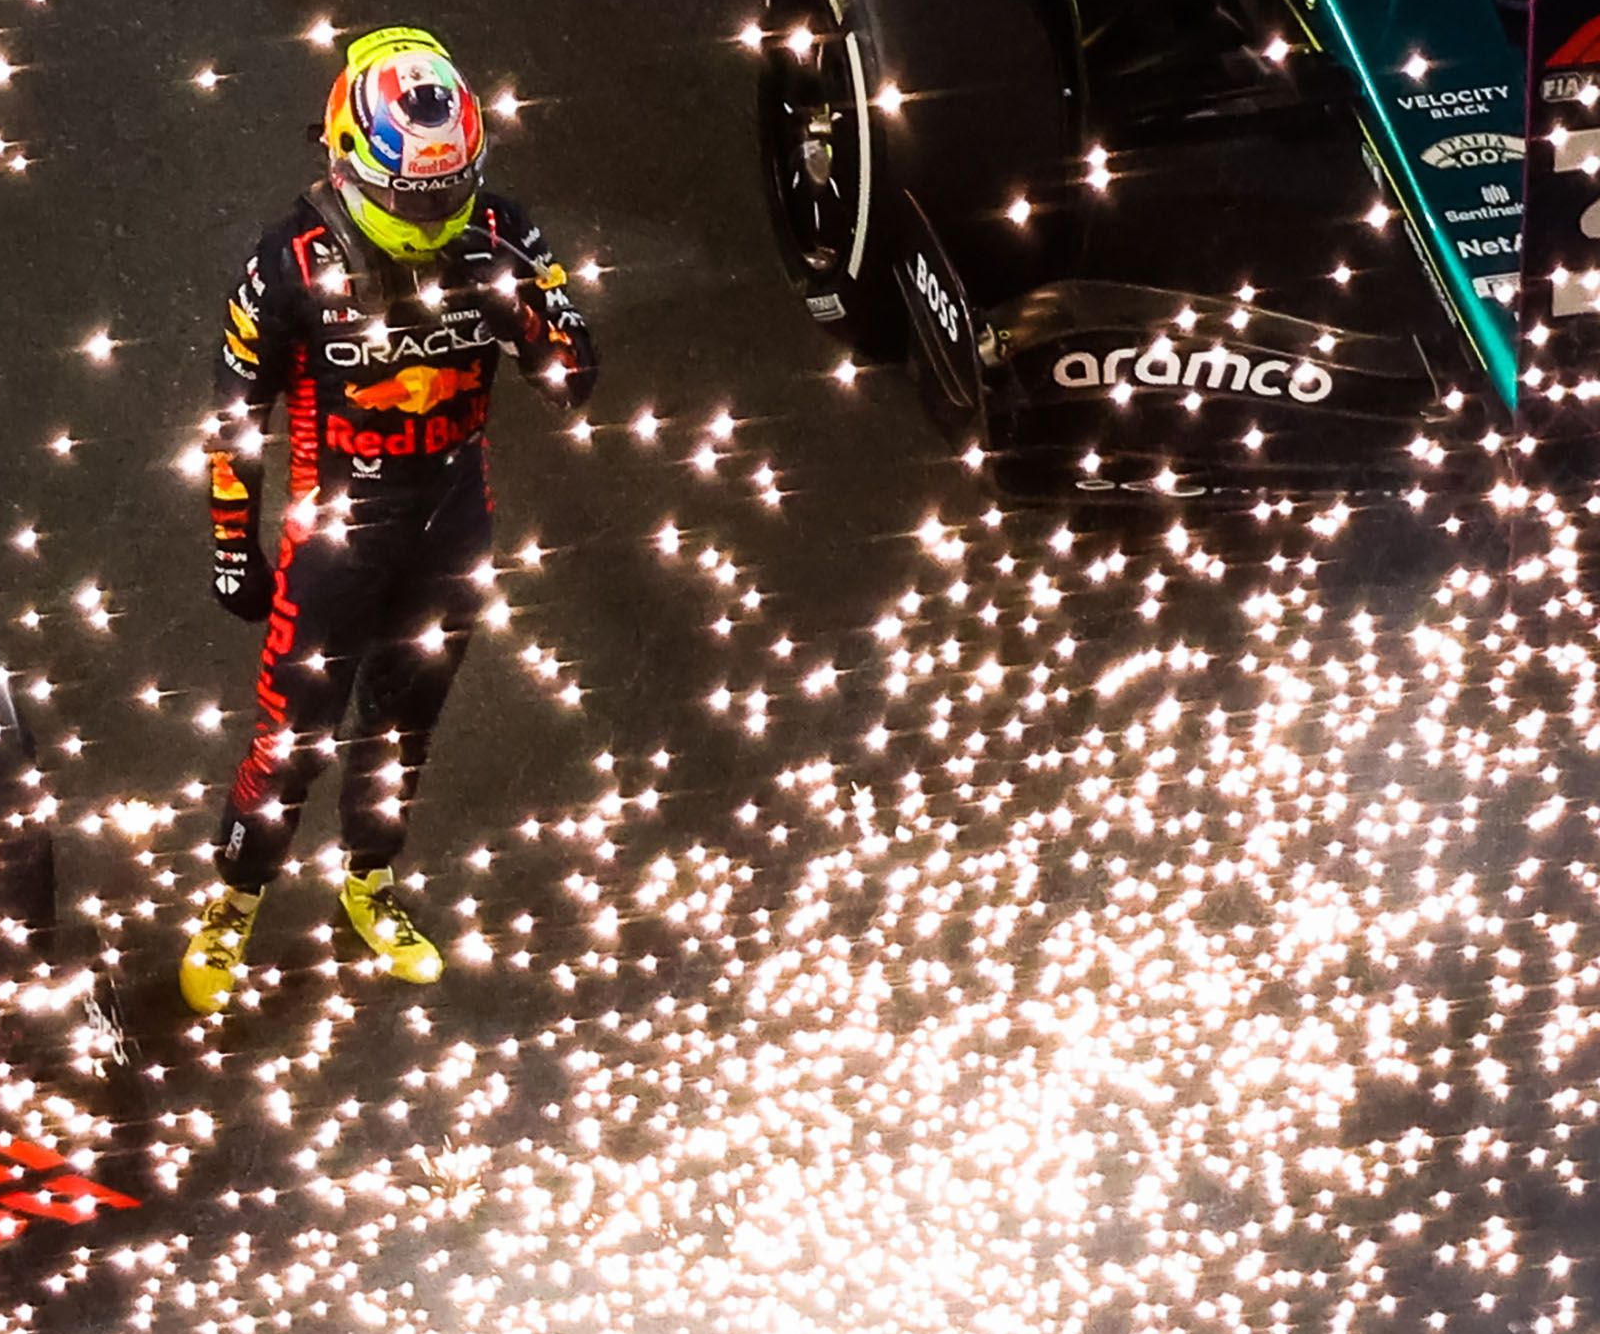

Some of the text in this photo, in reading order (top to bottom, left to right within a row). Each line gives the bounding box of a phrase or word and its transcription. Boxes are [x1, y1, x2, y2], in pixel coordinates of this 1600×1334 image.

[1397, 85, 1510, 110] VELOCITY
[1542, 77, 1580, 100] FIA
[1430, 102, 1491, 120] BLACK
[916, 251, 958, 344] BOSS
[1052, 347, 1333, 403] aramco
